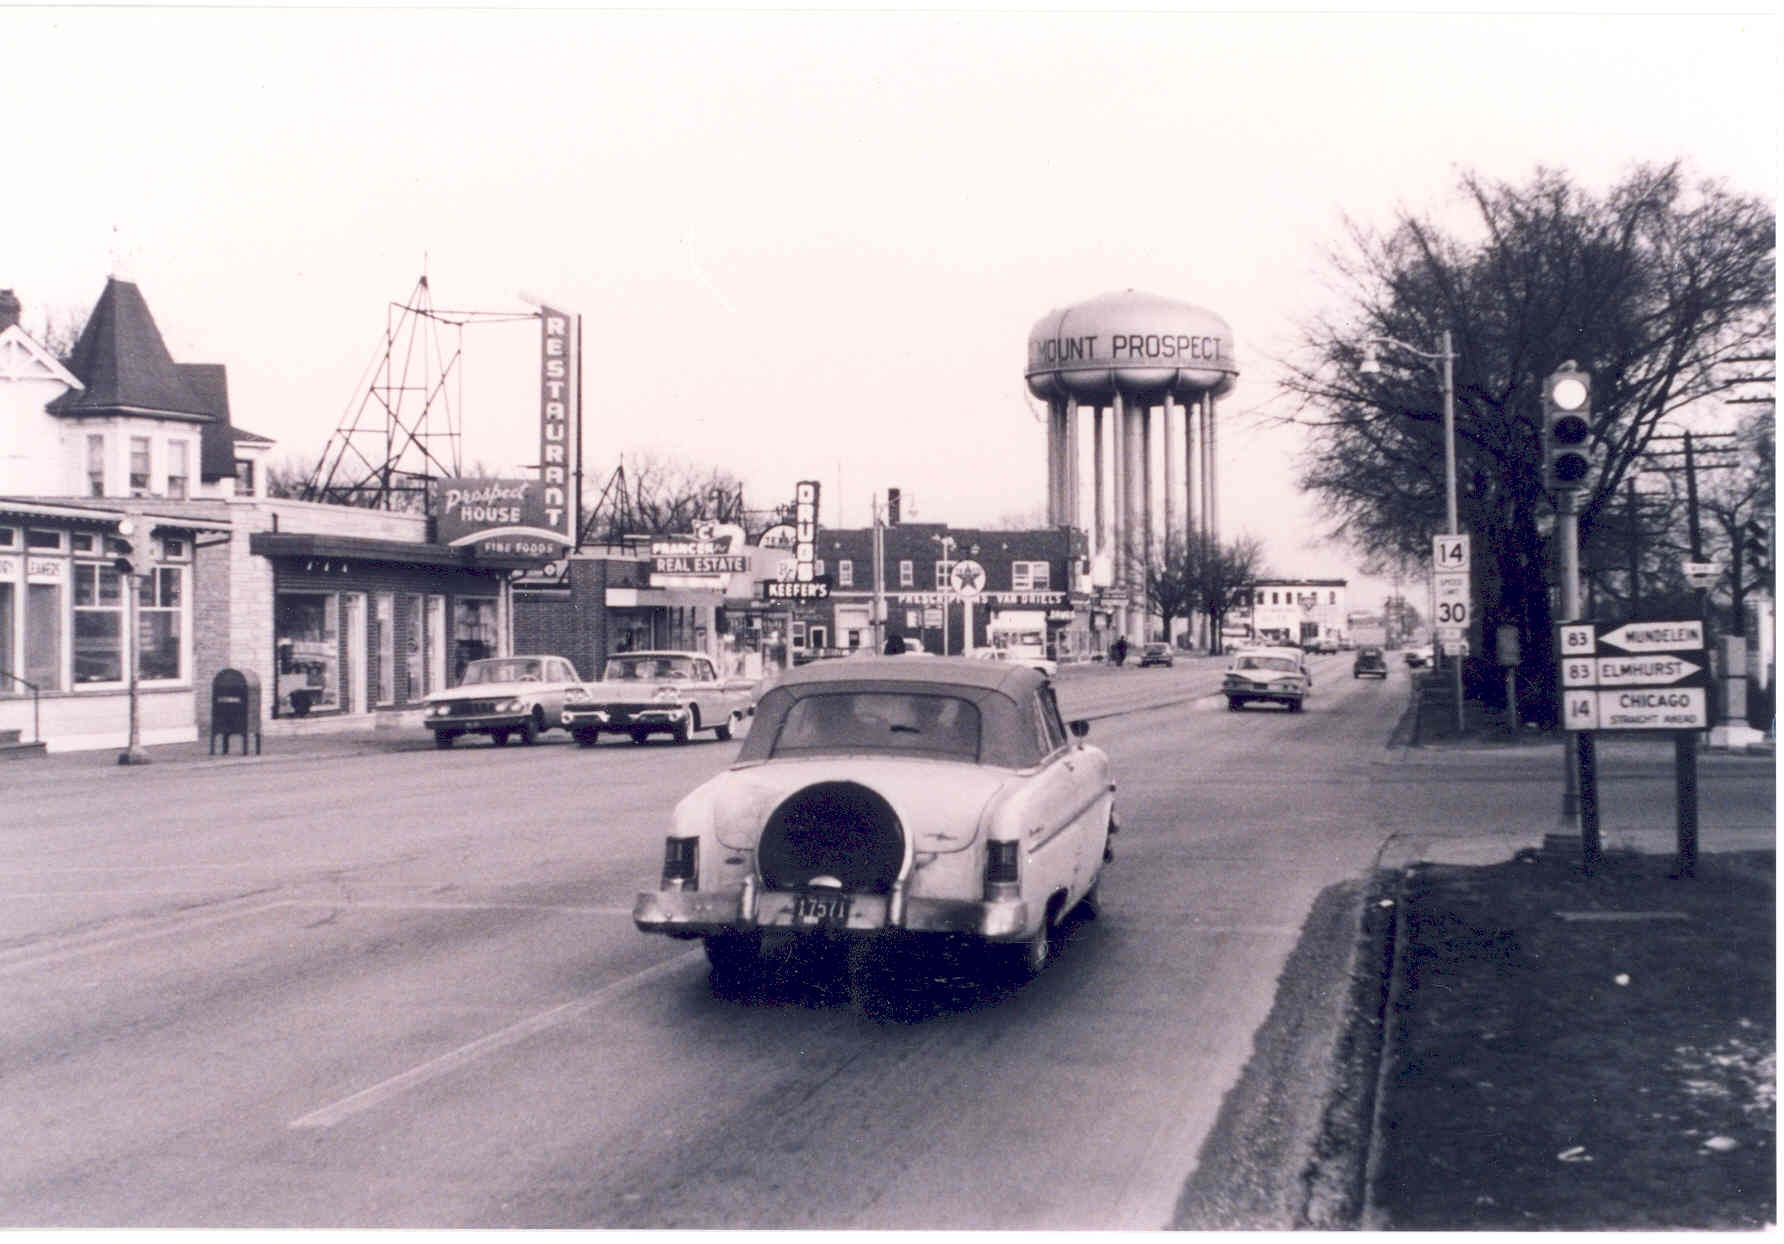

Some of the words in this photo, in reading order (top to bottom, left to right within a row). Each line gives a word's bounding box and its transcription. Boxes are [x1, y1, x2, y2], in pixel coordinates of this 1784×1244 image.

[1037, 336, 1098, 362] MOUNT
[1112, 334, 1222, 361] PROSPECT
[545, 316, 566, 527] RESTAURANT
[445, 482, 529, 514] Prospect
[461, 507, 521, 522] HOUSE
[1439, 543, 1463, 563] 14
[657, 558, 690, 573] REAL
[694, 556, 744, 573] ESTATE
[768, 583, 828, 597] KEEFER'S
[1439, 603, 1466, 622] 30
[1567, 632, 1588, 647] 83
[1625, 628, 1699, 644] MUNDELEIN
[1569, 664, 1590, 679] 83
[1602, 662, 1683, 678] ELMHURST
[1571, 701, 1590, 717] 14
[1619, 694, 1691, 708] CHICAGO
[1609, 714, 1660, 725] STRAIGHT
[1663, 714, 1697, 724] AHEAD
